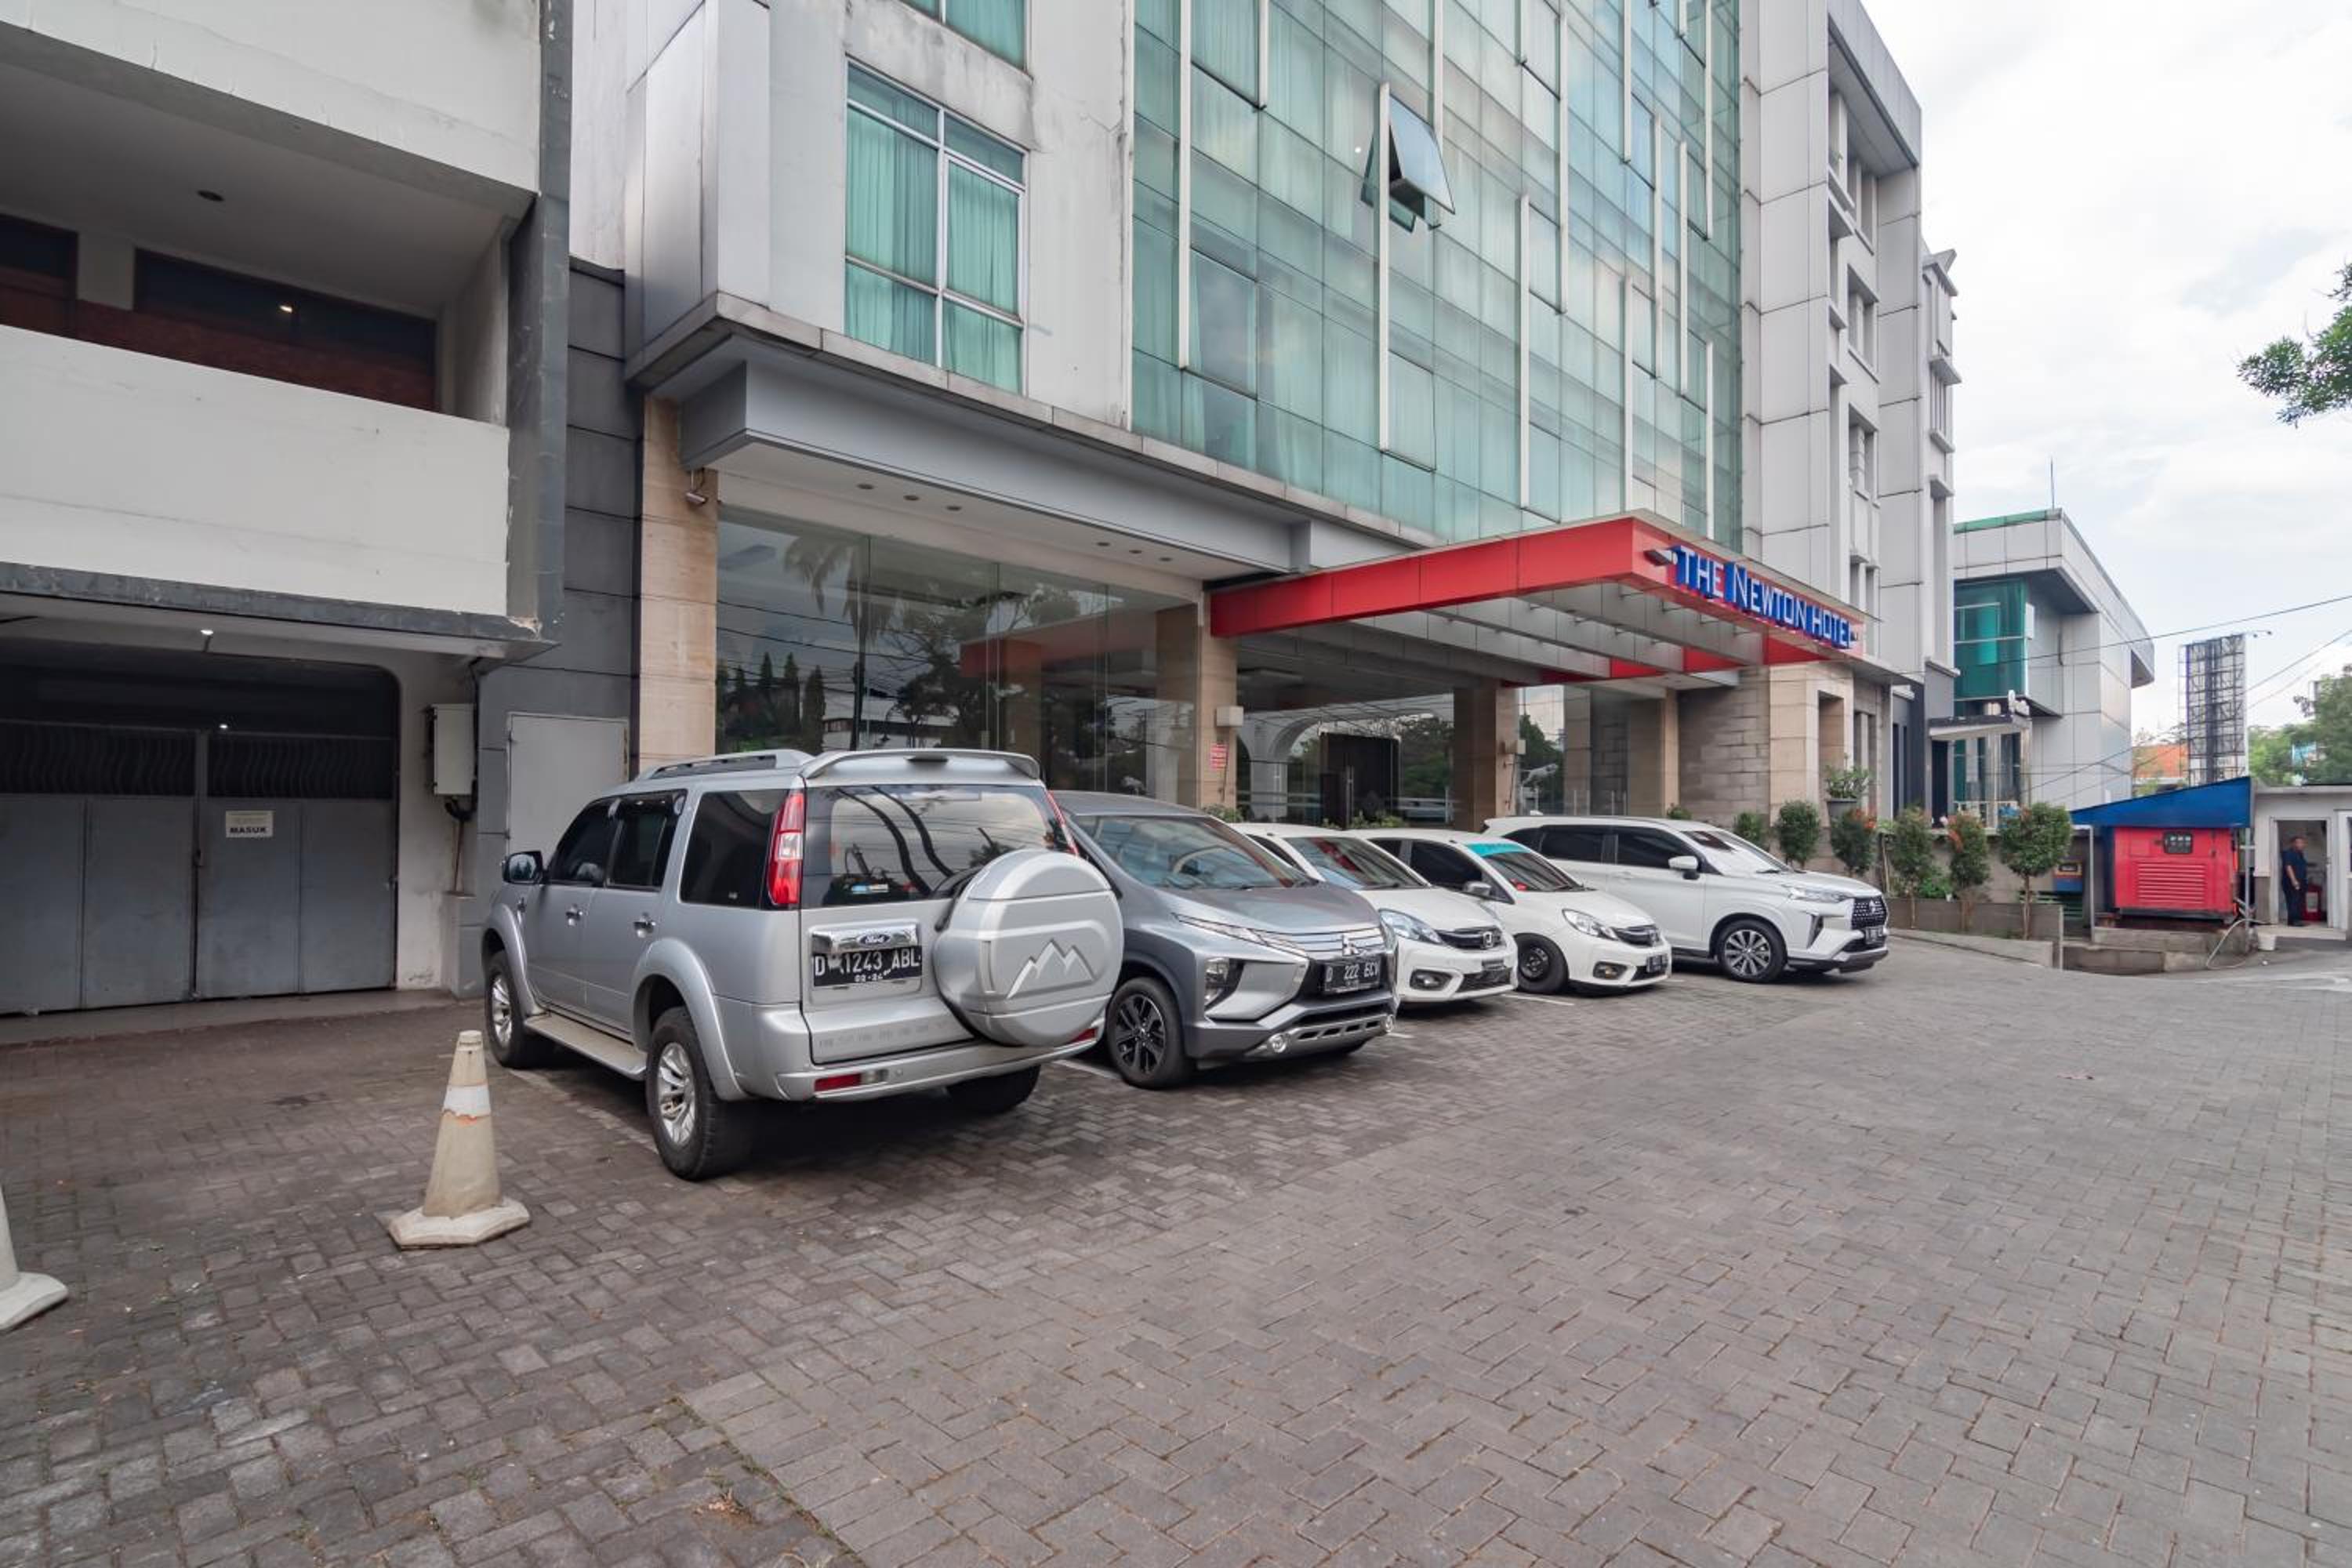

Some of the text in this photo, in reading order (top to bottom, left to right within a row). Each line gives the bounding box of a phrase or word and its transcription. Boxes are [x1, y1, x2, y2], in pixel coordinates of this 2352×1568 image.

[1680, 546, 1724, 598] THE
[1731, 563, 1807, 630] NEWTON
[815, 948, 920, 976] D 1243 ABL
[1343, 964, 1360, 980] 222
